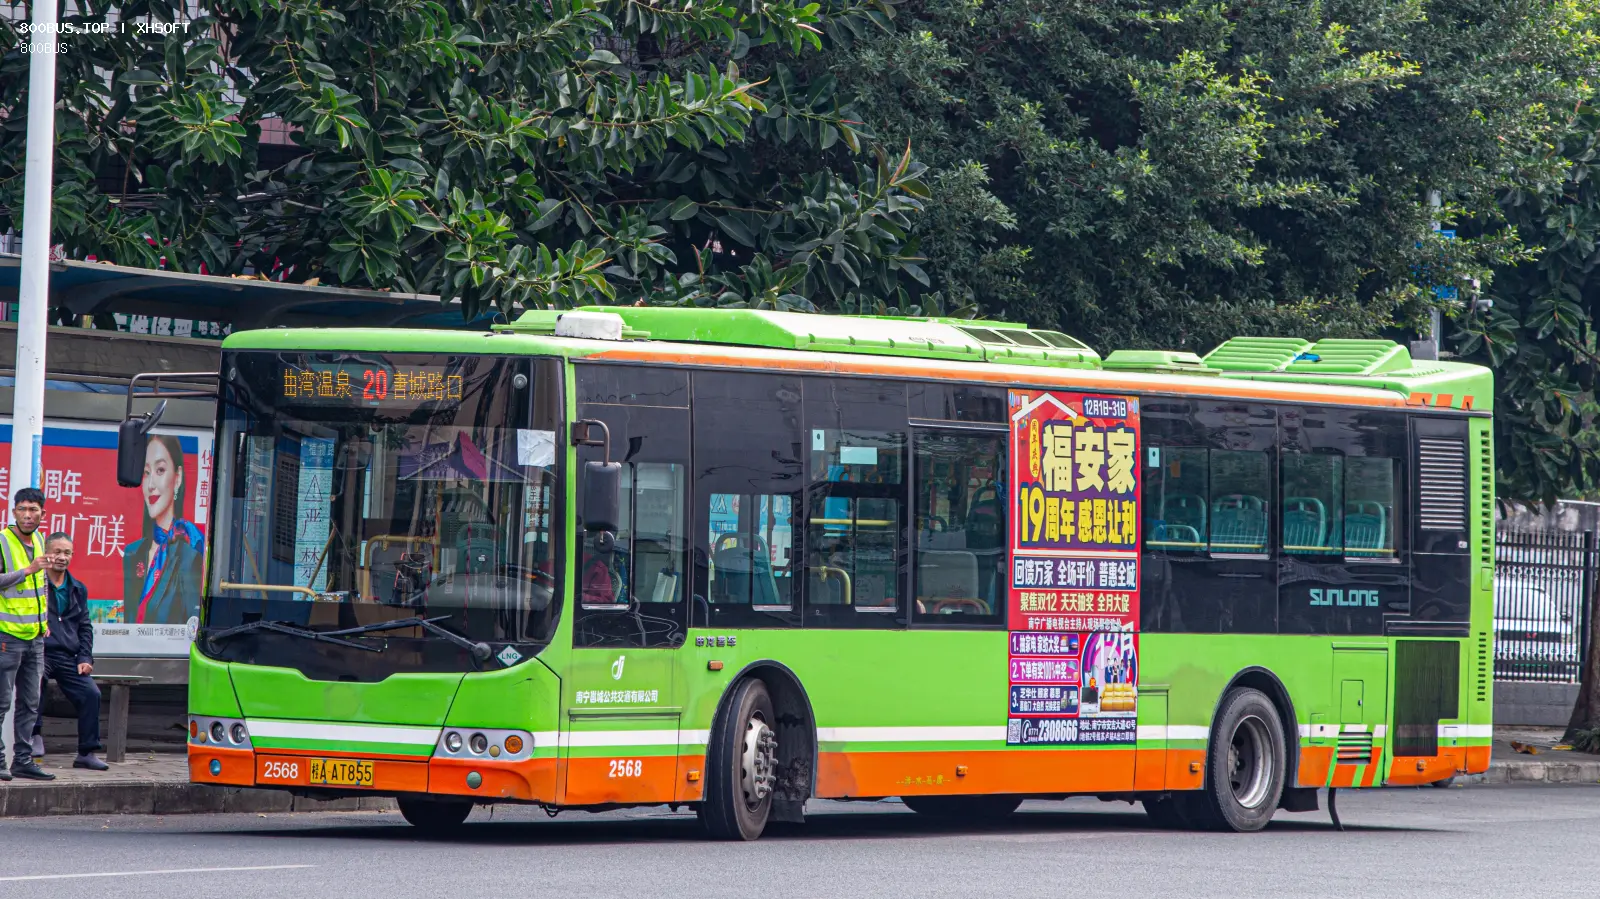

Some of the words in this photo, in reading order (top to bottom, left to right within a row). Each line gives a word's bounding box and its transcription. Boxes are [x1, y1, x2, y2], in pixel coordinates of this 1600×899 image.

[363, 369, 388, 400] 20
[1042, 424, 1136, 494] 福安家
[1020, 487, 1076, 543] 19周年
[1077, 498, 1137, 545] 感恩让利
[1014, 559, 1054, 586] 回馈万家
[1057, 560, 1096, 588] 全场平价
[1099, 561, 1137, 588] 普惠全城
[1020, 592, 1057, 612] 聚焦双12
[1060, 593, 1095, 613] 天天抽奖
[1097, 593, 1130, 613] 全月大促
[1309, 588, 1379, 607] SUNLONG
[501, 652, 518, 660] LNG
[1038, 719, 1078, 742] 2308666
[264, 761, 298, 779] 2568
[609, 759, 642, 778] 2568
